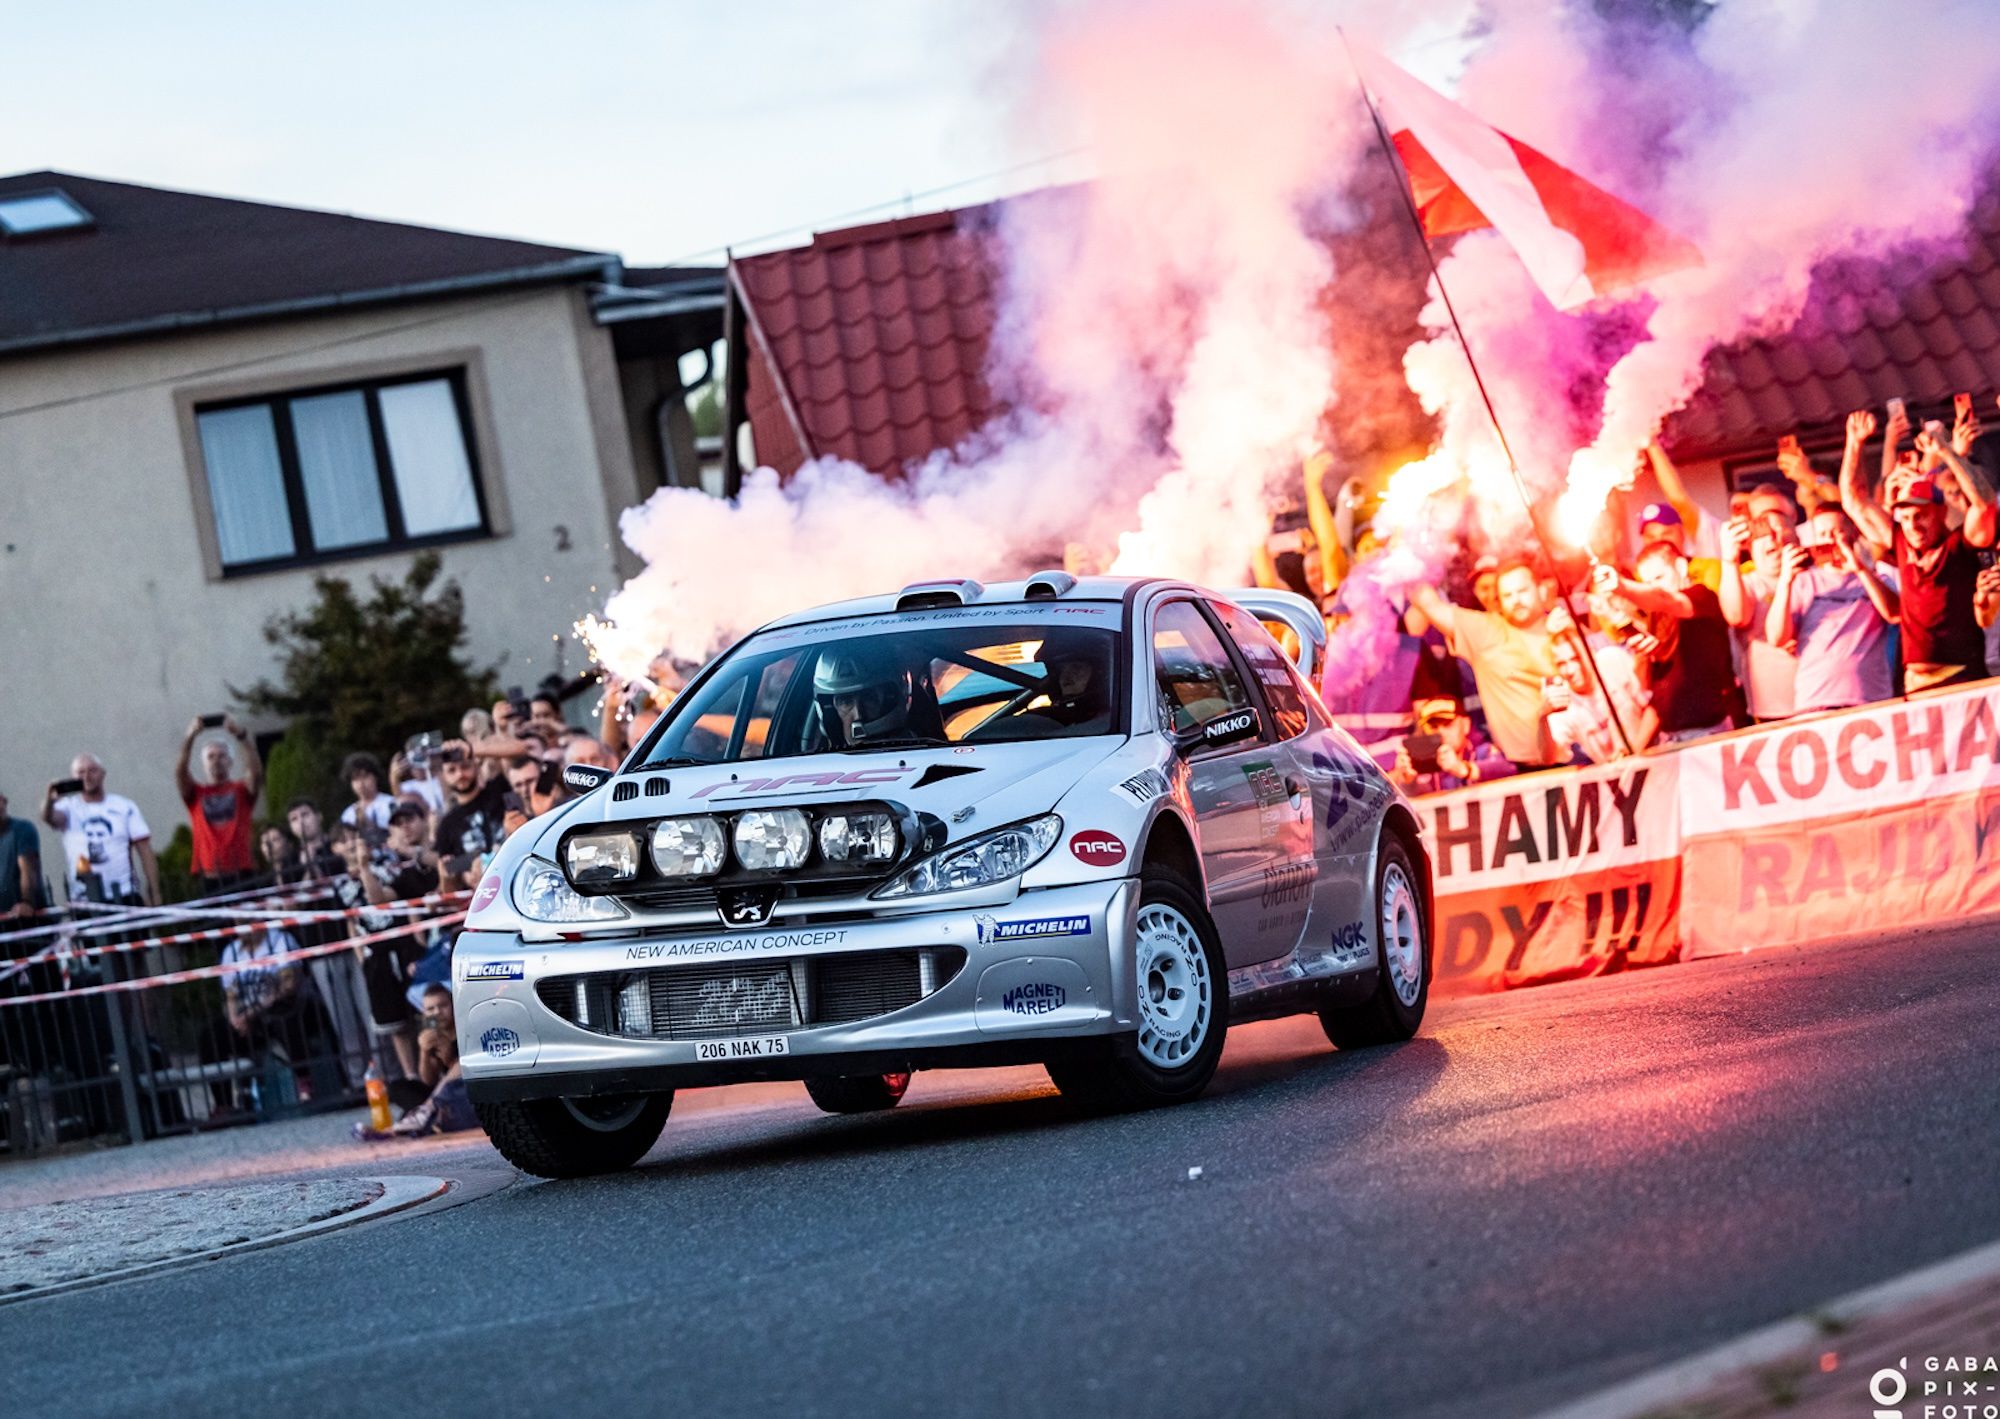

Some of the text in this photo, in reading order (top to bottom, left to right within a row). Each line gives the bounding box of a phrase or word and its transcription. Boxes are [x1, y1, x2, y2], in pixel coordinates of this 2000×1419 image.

[804, 623, 848, 635] Driven
[851, 621, 869, 630] by
[932, 609, 981, 620] United
[982, 609, 1003, 617] by
[1006, 608, 1047, 616] Sport
[1205, 715, 1251, 739] NIKKO
[1721, 694, 2000, 810] KOCHA
[562, 772, 599, 787] NIKKO
[1418, 768, 1649, 877] HAMY
[1000, 919, 1087, 937] MICHELIN
[1331, 921, 1367, 953] NGK
[626, 931, 848, 960] NEW AMERICAN CONCEPT
[469, 963, 524, 977] MICHELIN
[1003, 983, 1066, 1005] MAGNETI
[1003, 995, 1066, 1016] MARELLI
[700, 1038, 784, 1059] 206 NAK 75
